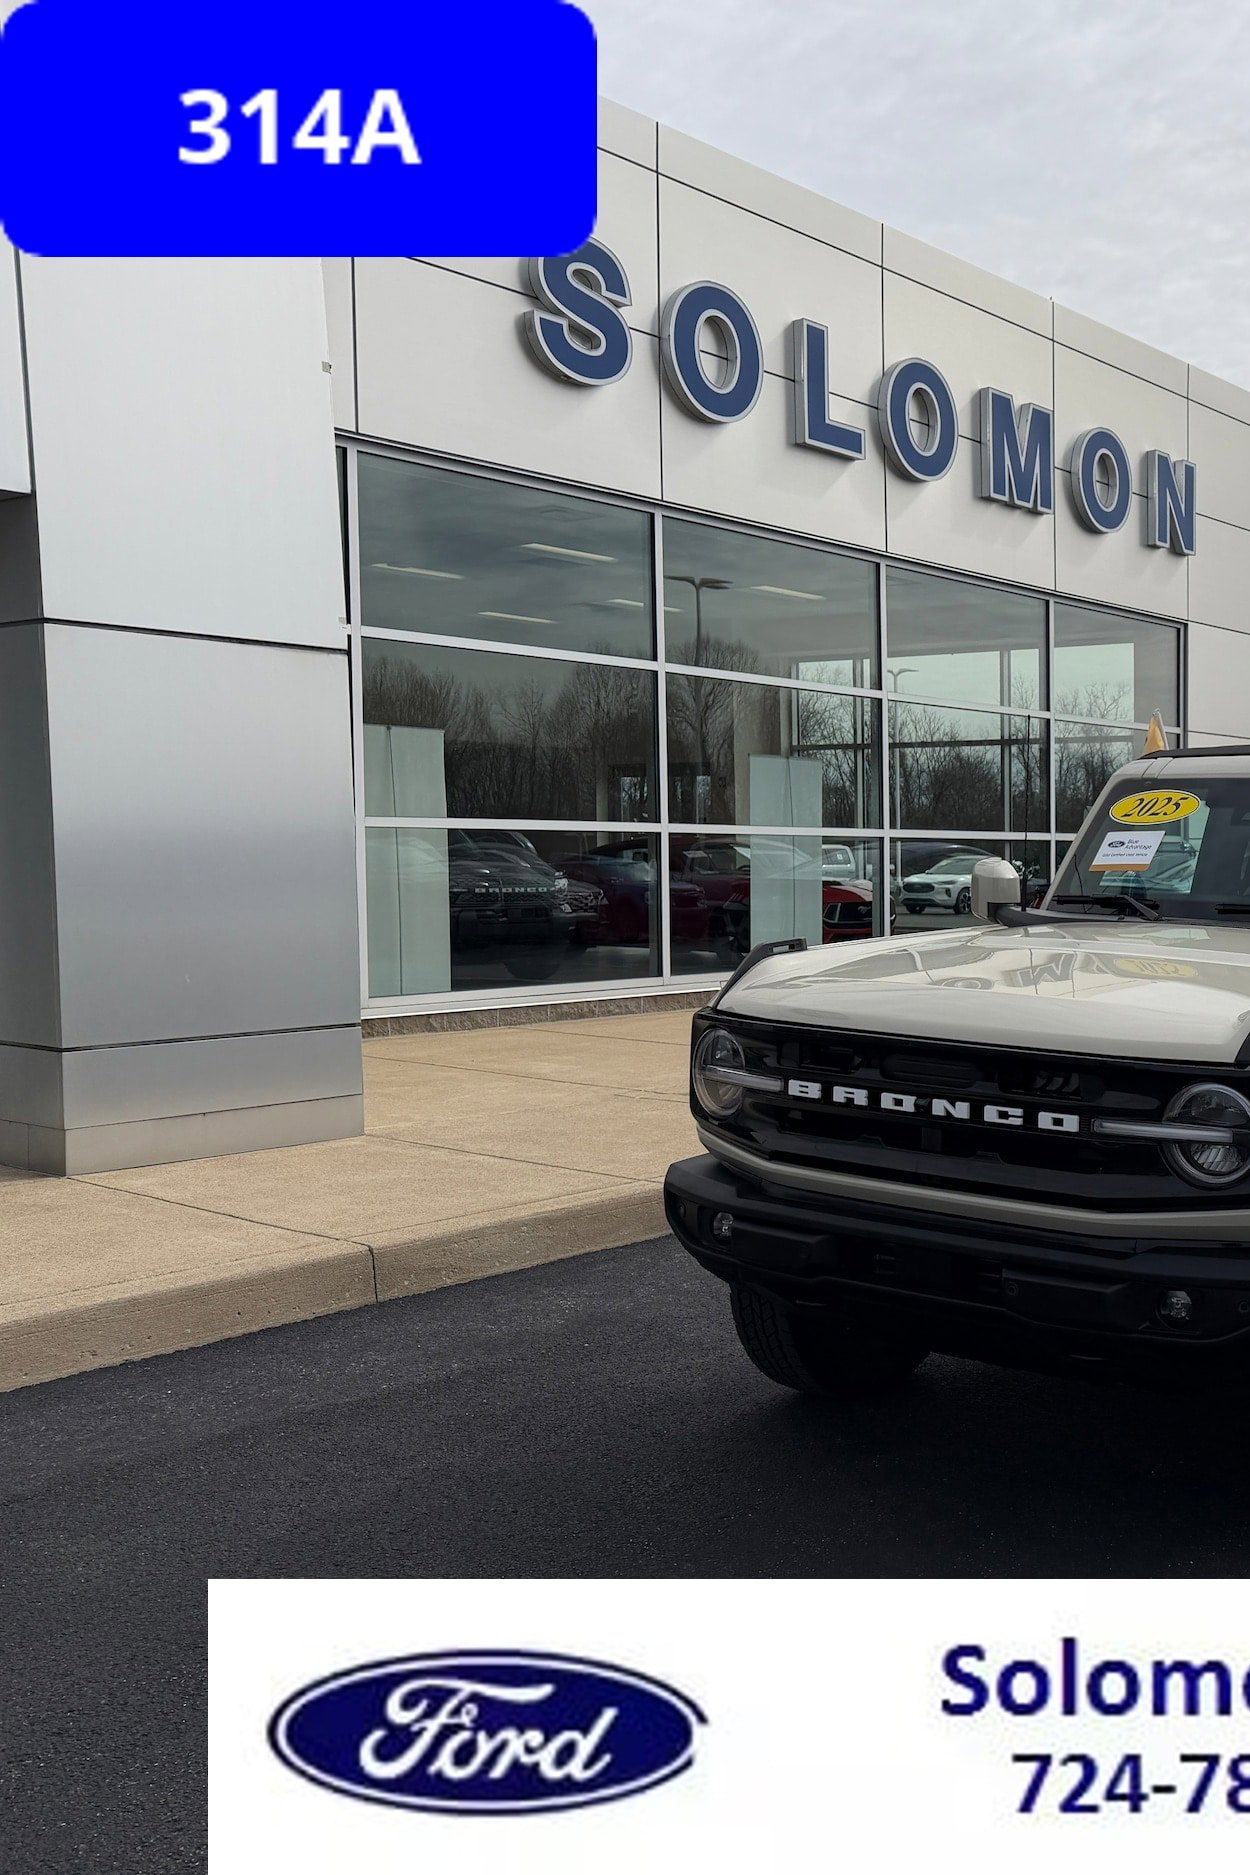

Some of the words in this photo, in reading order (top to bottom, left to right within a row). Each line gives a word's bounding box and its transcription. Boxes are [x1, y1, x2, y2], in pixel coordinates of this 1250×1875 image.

[524, 236, 1197, 556] SOLOMON
[1121, 797, 1190, 818] 2025
[787, 1078, 1081, 1134] BRONCO
